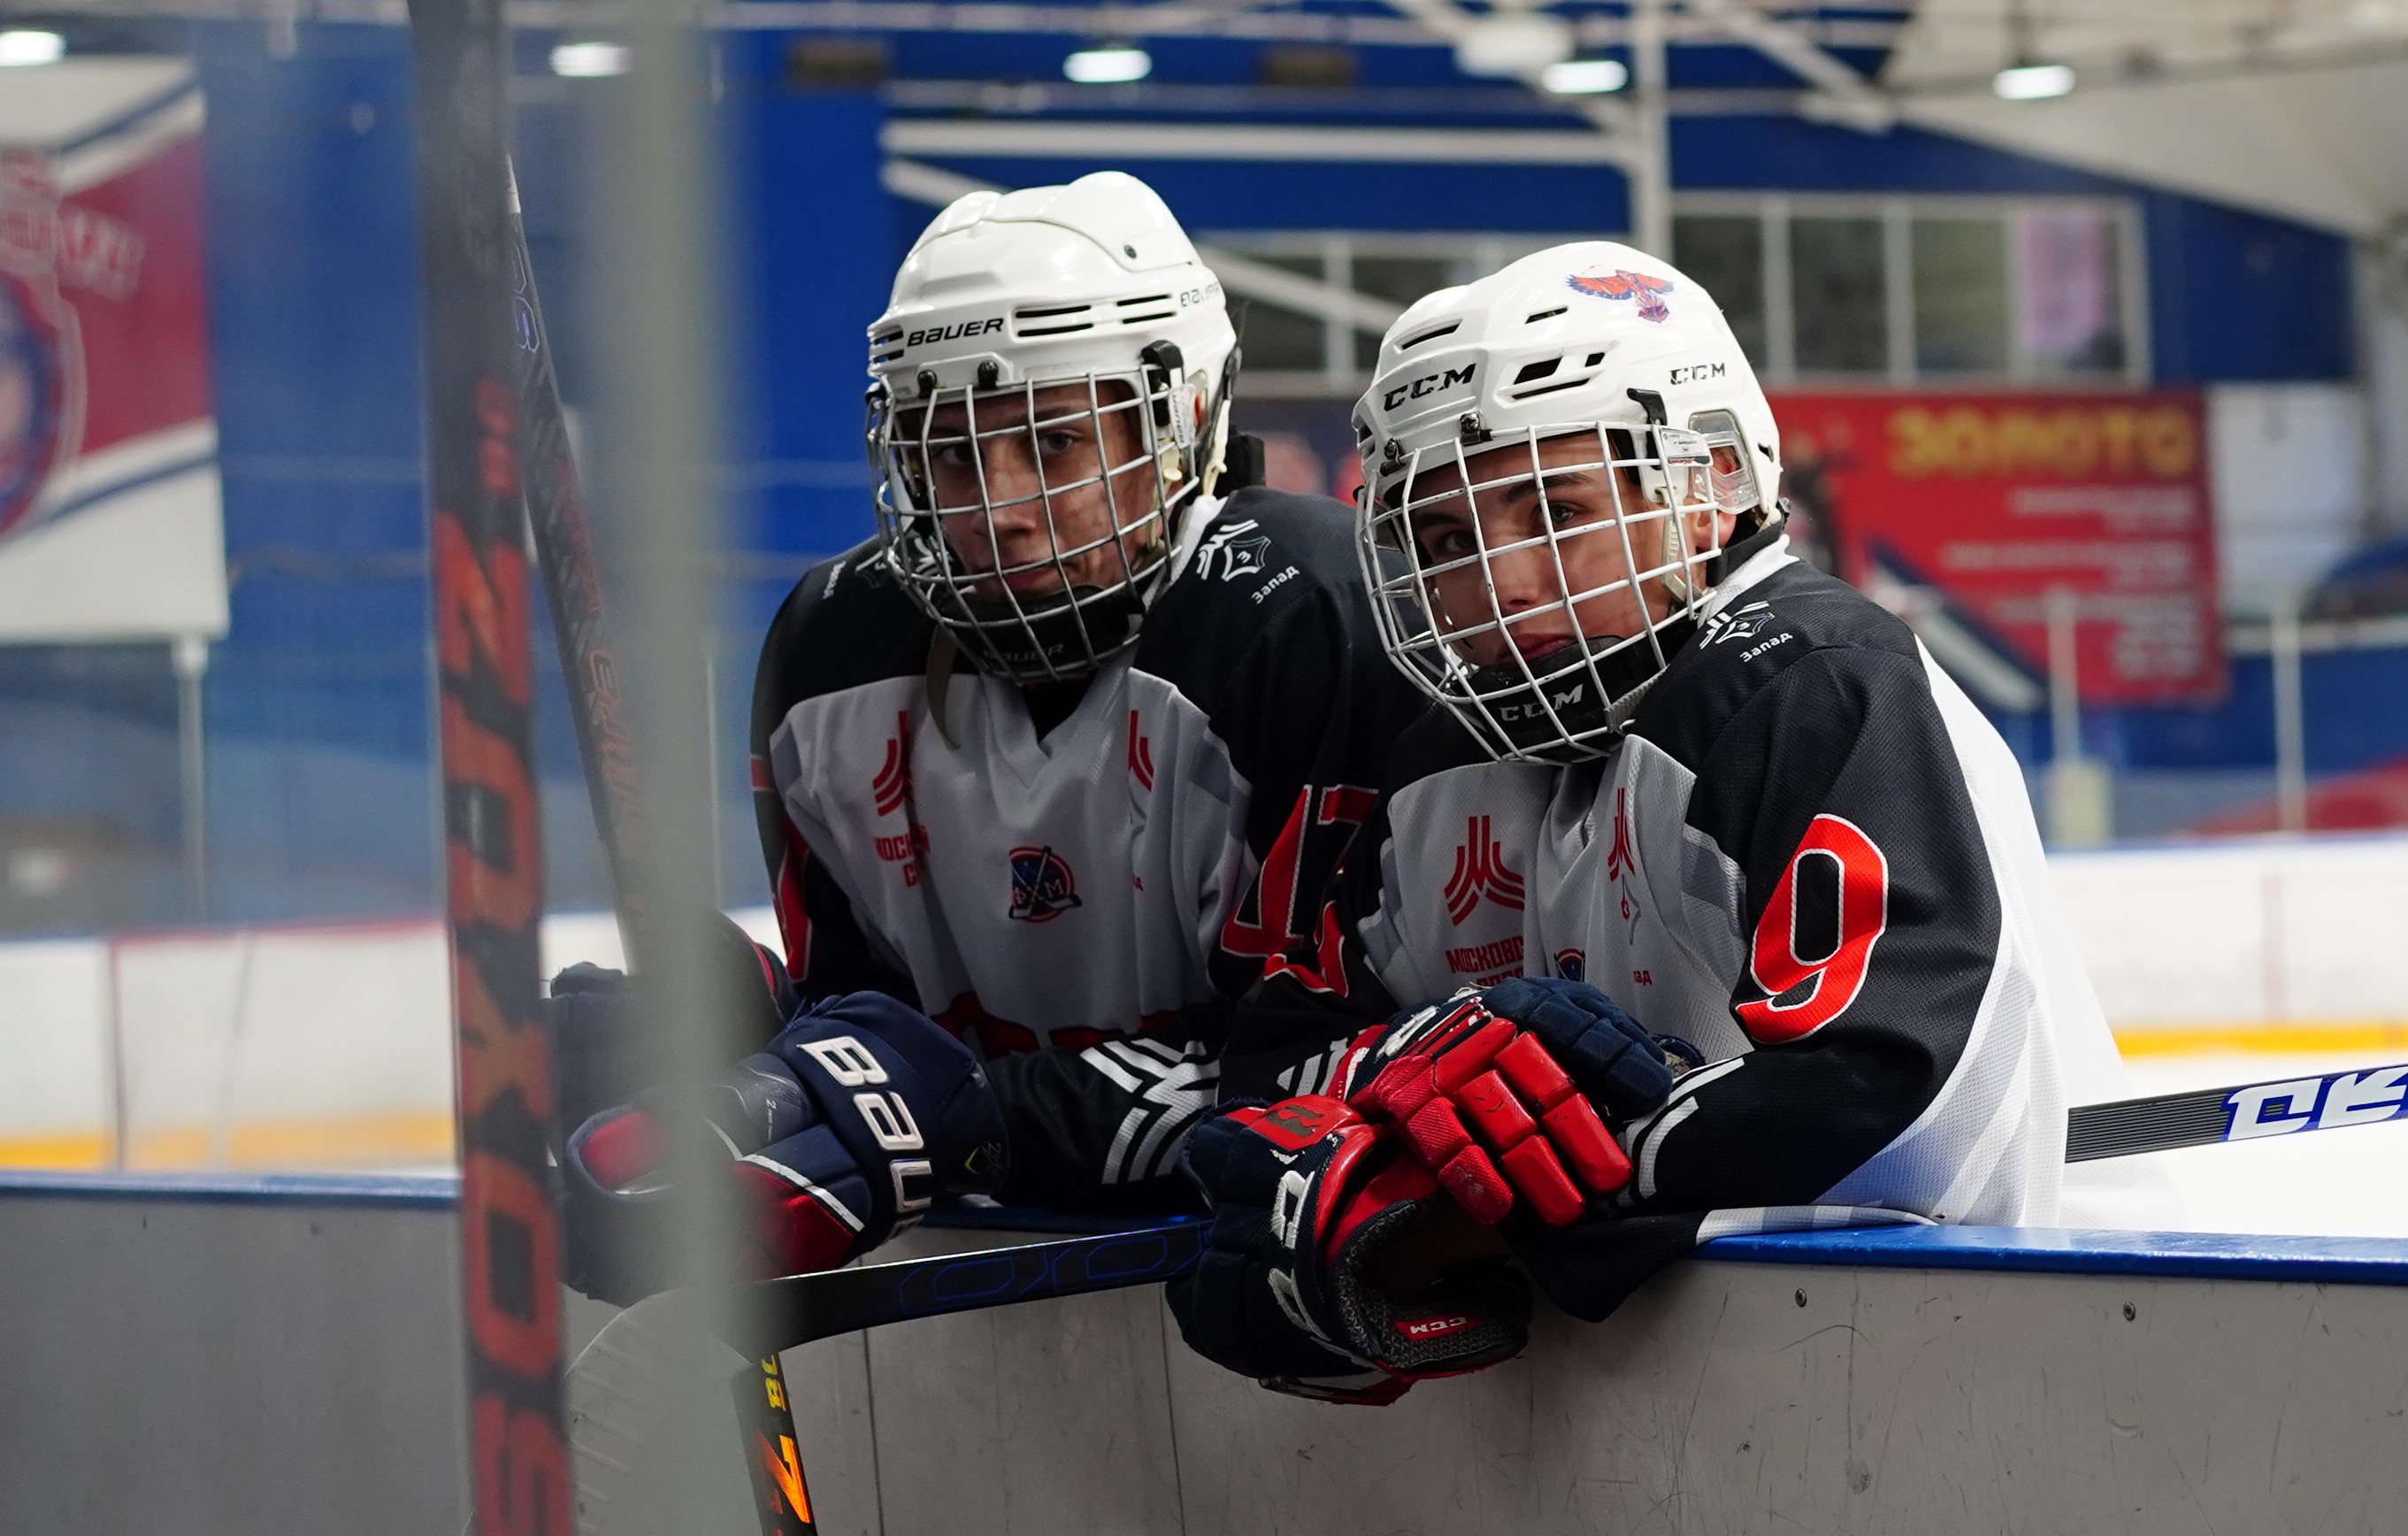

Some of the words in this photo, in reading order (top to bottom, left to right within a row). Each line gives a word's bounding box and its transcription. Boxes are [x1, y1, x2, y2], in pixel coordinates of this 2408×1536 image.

[1384, 364, 1477, 411] CCM
[1671, 364, 1726, 385] CCM
[1251, 565, 1300, 604] Запад
[1739, 634, 1794, 664] Запад
[1500, 685, 1585, 722] CCM
[1736, 813, 1888, 1043] 9
[1410, 1317, 1468, 1334] CCM
